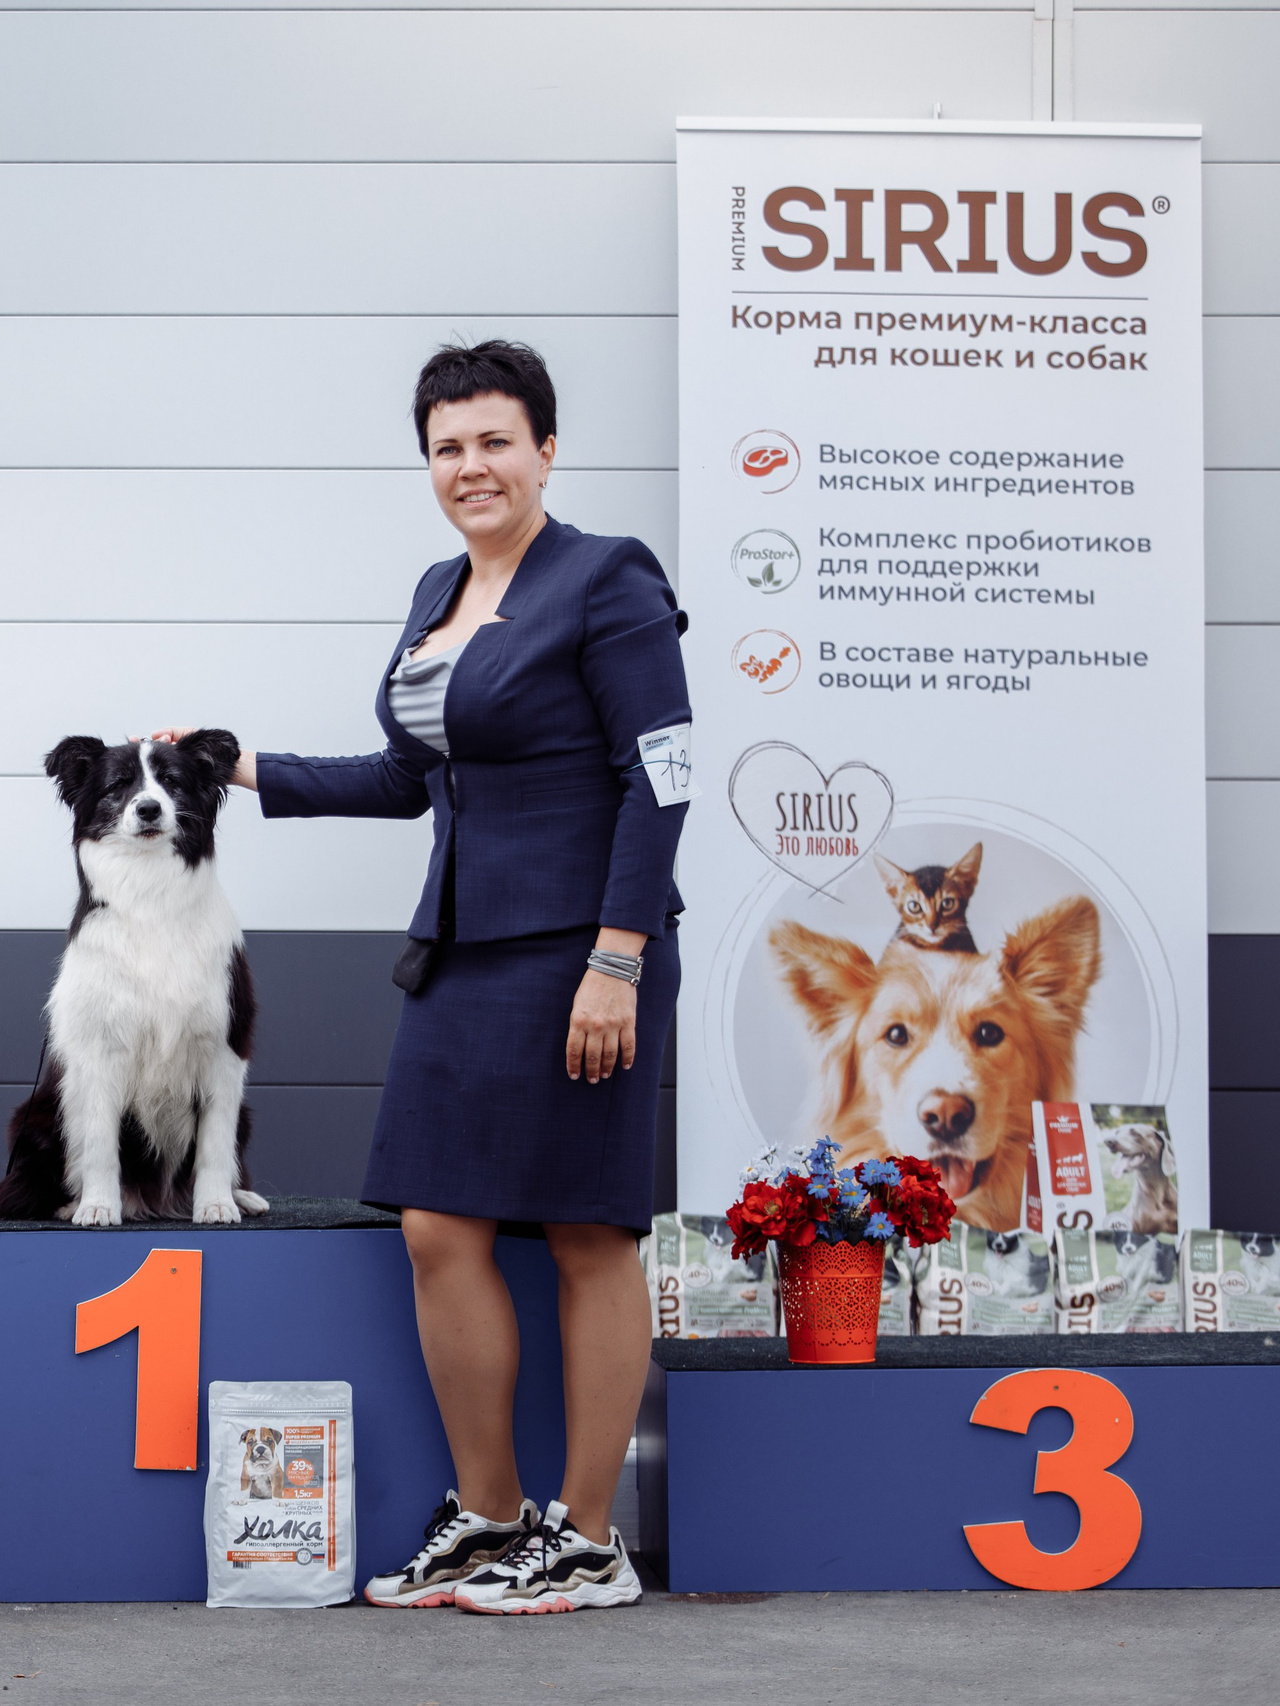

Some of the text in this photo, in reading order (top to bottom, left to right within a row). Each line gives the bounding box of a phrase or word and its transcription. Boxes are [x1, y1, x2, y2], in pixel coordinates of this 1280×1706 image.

[731, 186, 746, 271] PREMIUM
[732, 305, 1148, 338] Корма премиум-класса
[814, 344, 1148, 371] для кошек и собак
[820, 443, 1125, 472] Высокое содержание
[819, 474, 1135, 498] мясных ингредиентов
[819, 527, 1152, 555] Комплекс пробиотиков
[740, 548, 795, 560] ProStor+
[818, 557, 1039, 580] для поддержки
[819, 582, 1095, 606] иммунной системы
[820, 641, 1149, 669] В составе натуральные
[818, 671, 1031, 694] овощи и ягоды
[644, 735, 670, 747] Winner
[775, 792, 859, 833] SIRIUS
[775, 834, 859, 857] ЭТО ЛЮБОВЬ
[1056, 1167, 1085, 1177] ADULT
[75, 1248, 202, 1471] 1
[291, 1460, 313, 1471] 39%
[963, 1368, 1142, 1592] 3
[293, 1489, 313, 1499] 1,5кг
[233, 1515, 325, 1545] Холка
[246, 1541, 304, 1549] гипоаллергенный
